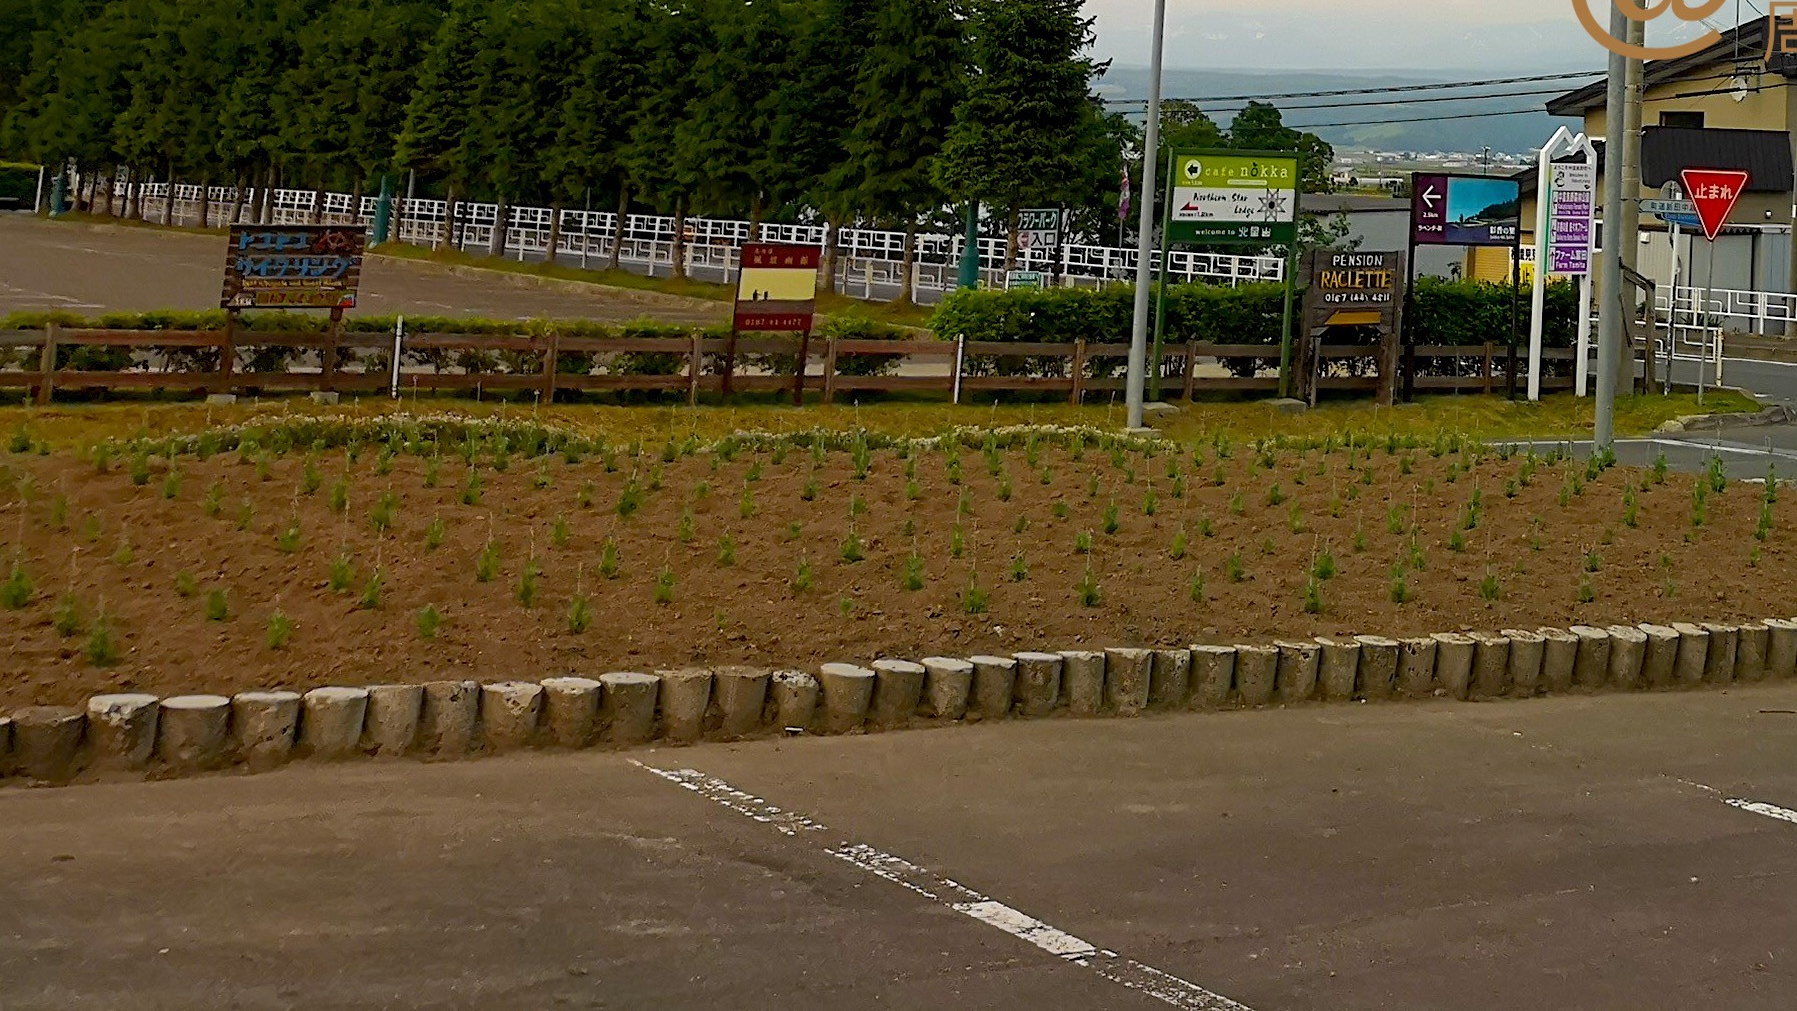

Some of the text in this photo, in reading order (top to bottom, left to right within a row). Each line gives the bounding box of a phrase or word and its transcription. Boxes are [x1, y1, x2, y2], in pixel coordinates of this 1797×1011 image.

[1205, 166, 1234, 177] cafe
[1231, 192, 1248, 202] Star
[1694, 183, 1733, 200] 止まれ
[1234, 204, 1255, 218] Lodge
[1195, 228, 1226, 236] welcome
[1031, 232, 1056, 246] 入口
[1332, 254, 1383, 266] PENSION
[1320, 270, 1392, 288] RACLETTE
[1324, 293, 1347, 302] 0167
